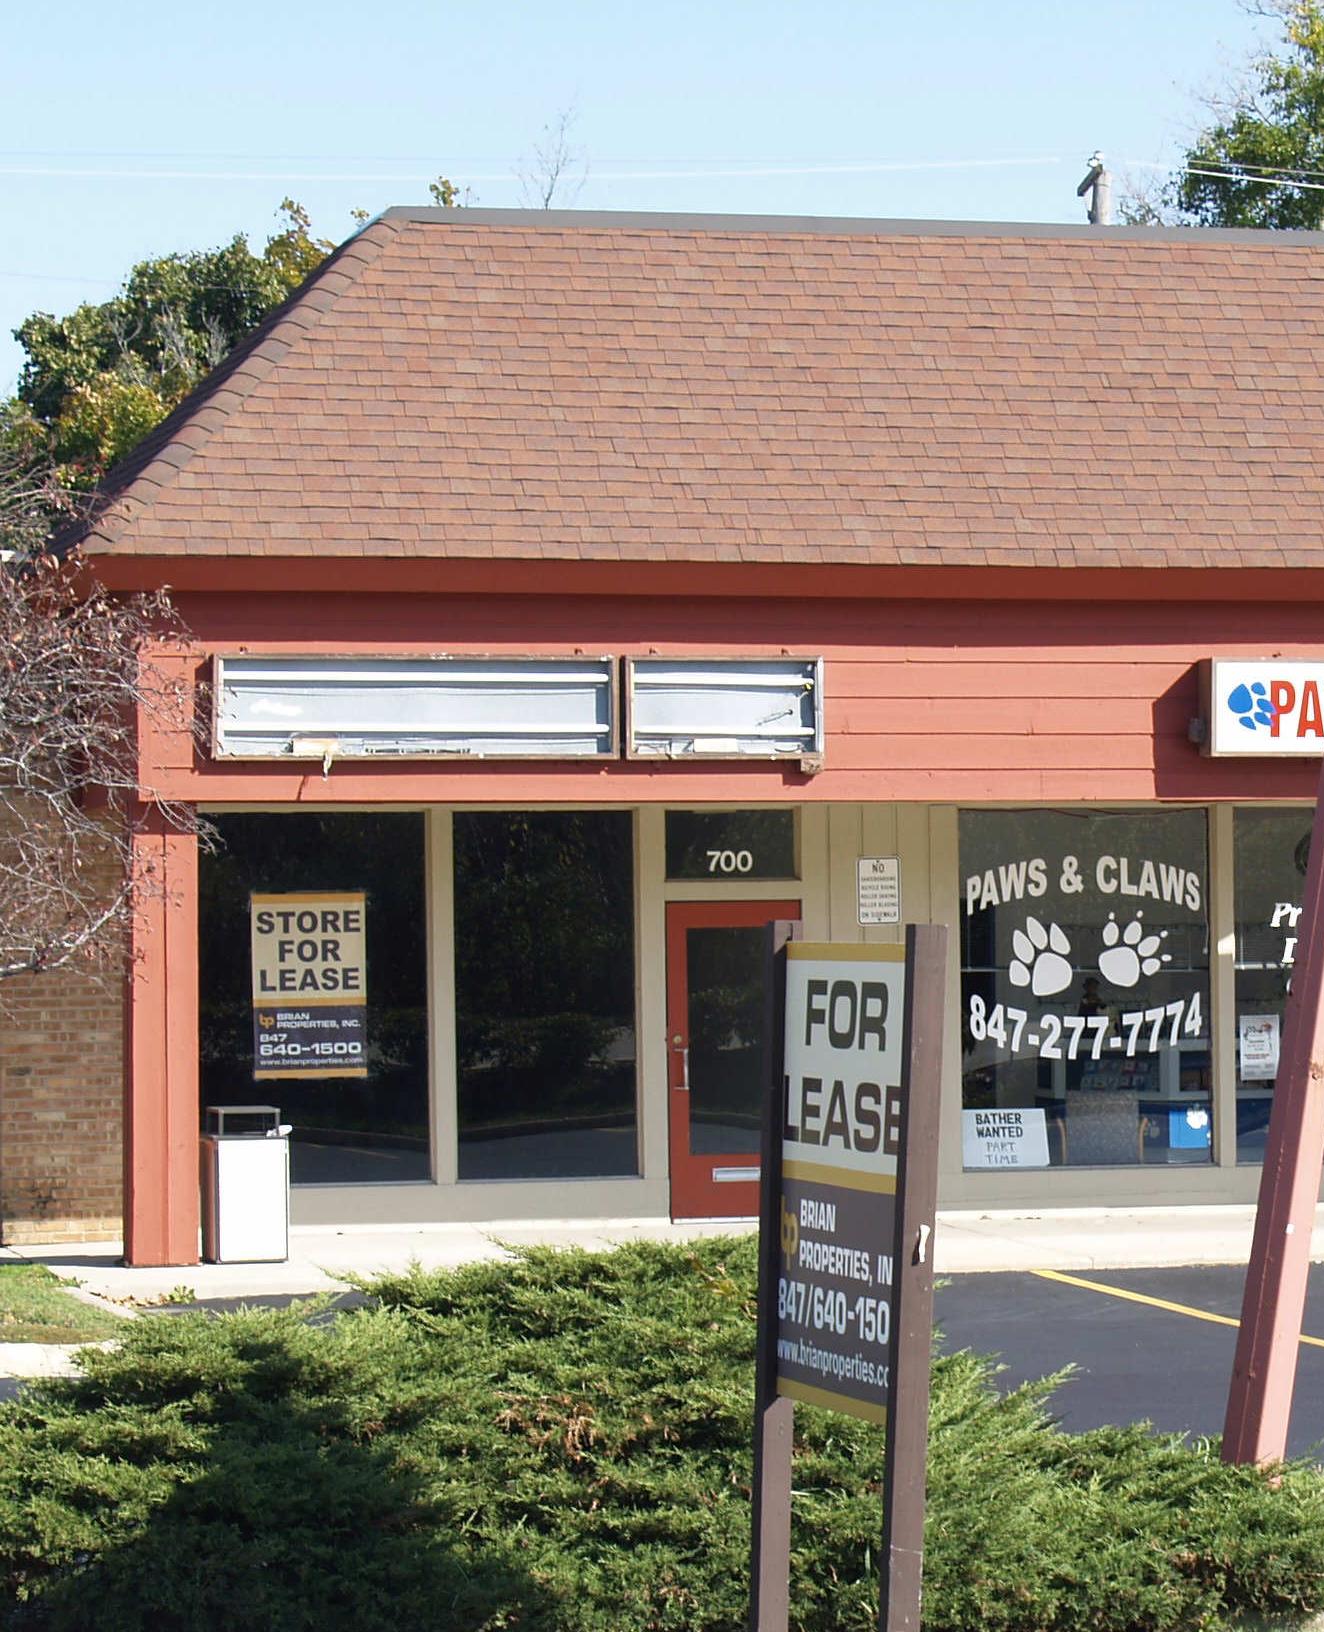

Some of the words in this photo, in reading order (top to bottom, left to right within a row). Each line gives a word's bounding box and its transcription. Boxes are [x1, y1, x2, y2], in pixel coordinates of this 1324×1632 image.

[706, 850, 753, 872] 700
[872, 863, 885, 873] NO
[966, 858, 1048, 916] PAWS
[1059, 855, 1084, 893] &
[1096, 855, 1201, 912] CLAWS
[256, 910, 361, 935] STORE
[278, 939, 342, 963] FOR
[259, 967, 361, 992] LEASE
[276, 1012, 310, 1021] BRIAN
[276, 1019, 340, 1029] PROPERTIES,
[342, 1019, 361, 1027] INC.
[805, 979, 889, 1052] FOR
[970, 991, 1202, 1060] 847-277-7774
[259, 1033, 287, 1043] 847
[259, 1042, 362, 1056] 640-1500
[783, 1074, 901, 1156] LEASE
[975, 1112, 1023, 1125] BATHER
[976, 1126, 1024, 1138] WANTED
[986, 1141, 1016, 1152] PART
[985, 1154, 1019, 1164] TIME
[799, 1198, 837, 1233] BRIAN
[799, 1239, 874, 1288] PROPERTIES,
[877, 1255, 894, 1286] IN
[778, 1277, 891, 1345] 847/640-150
